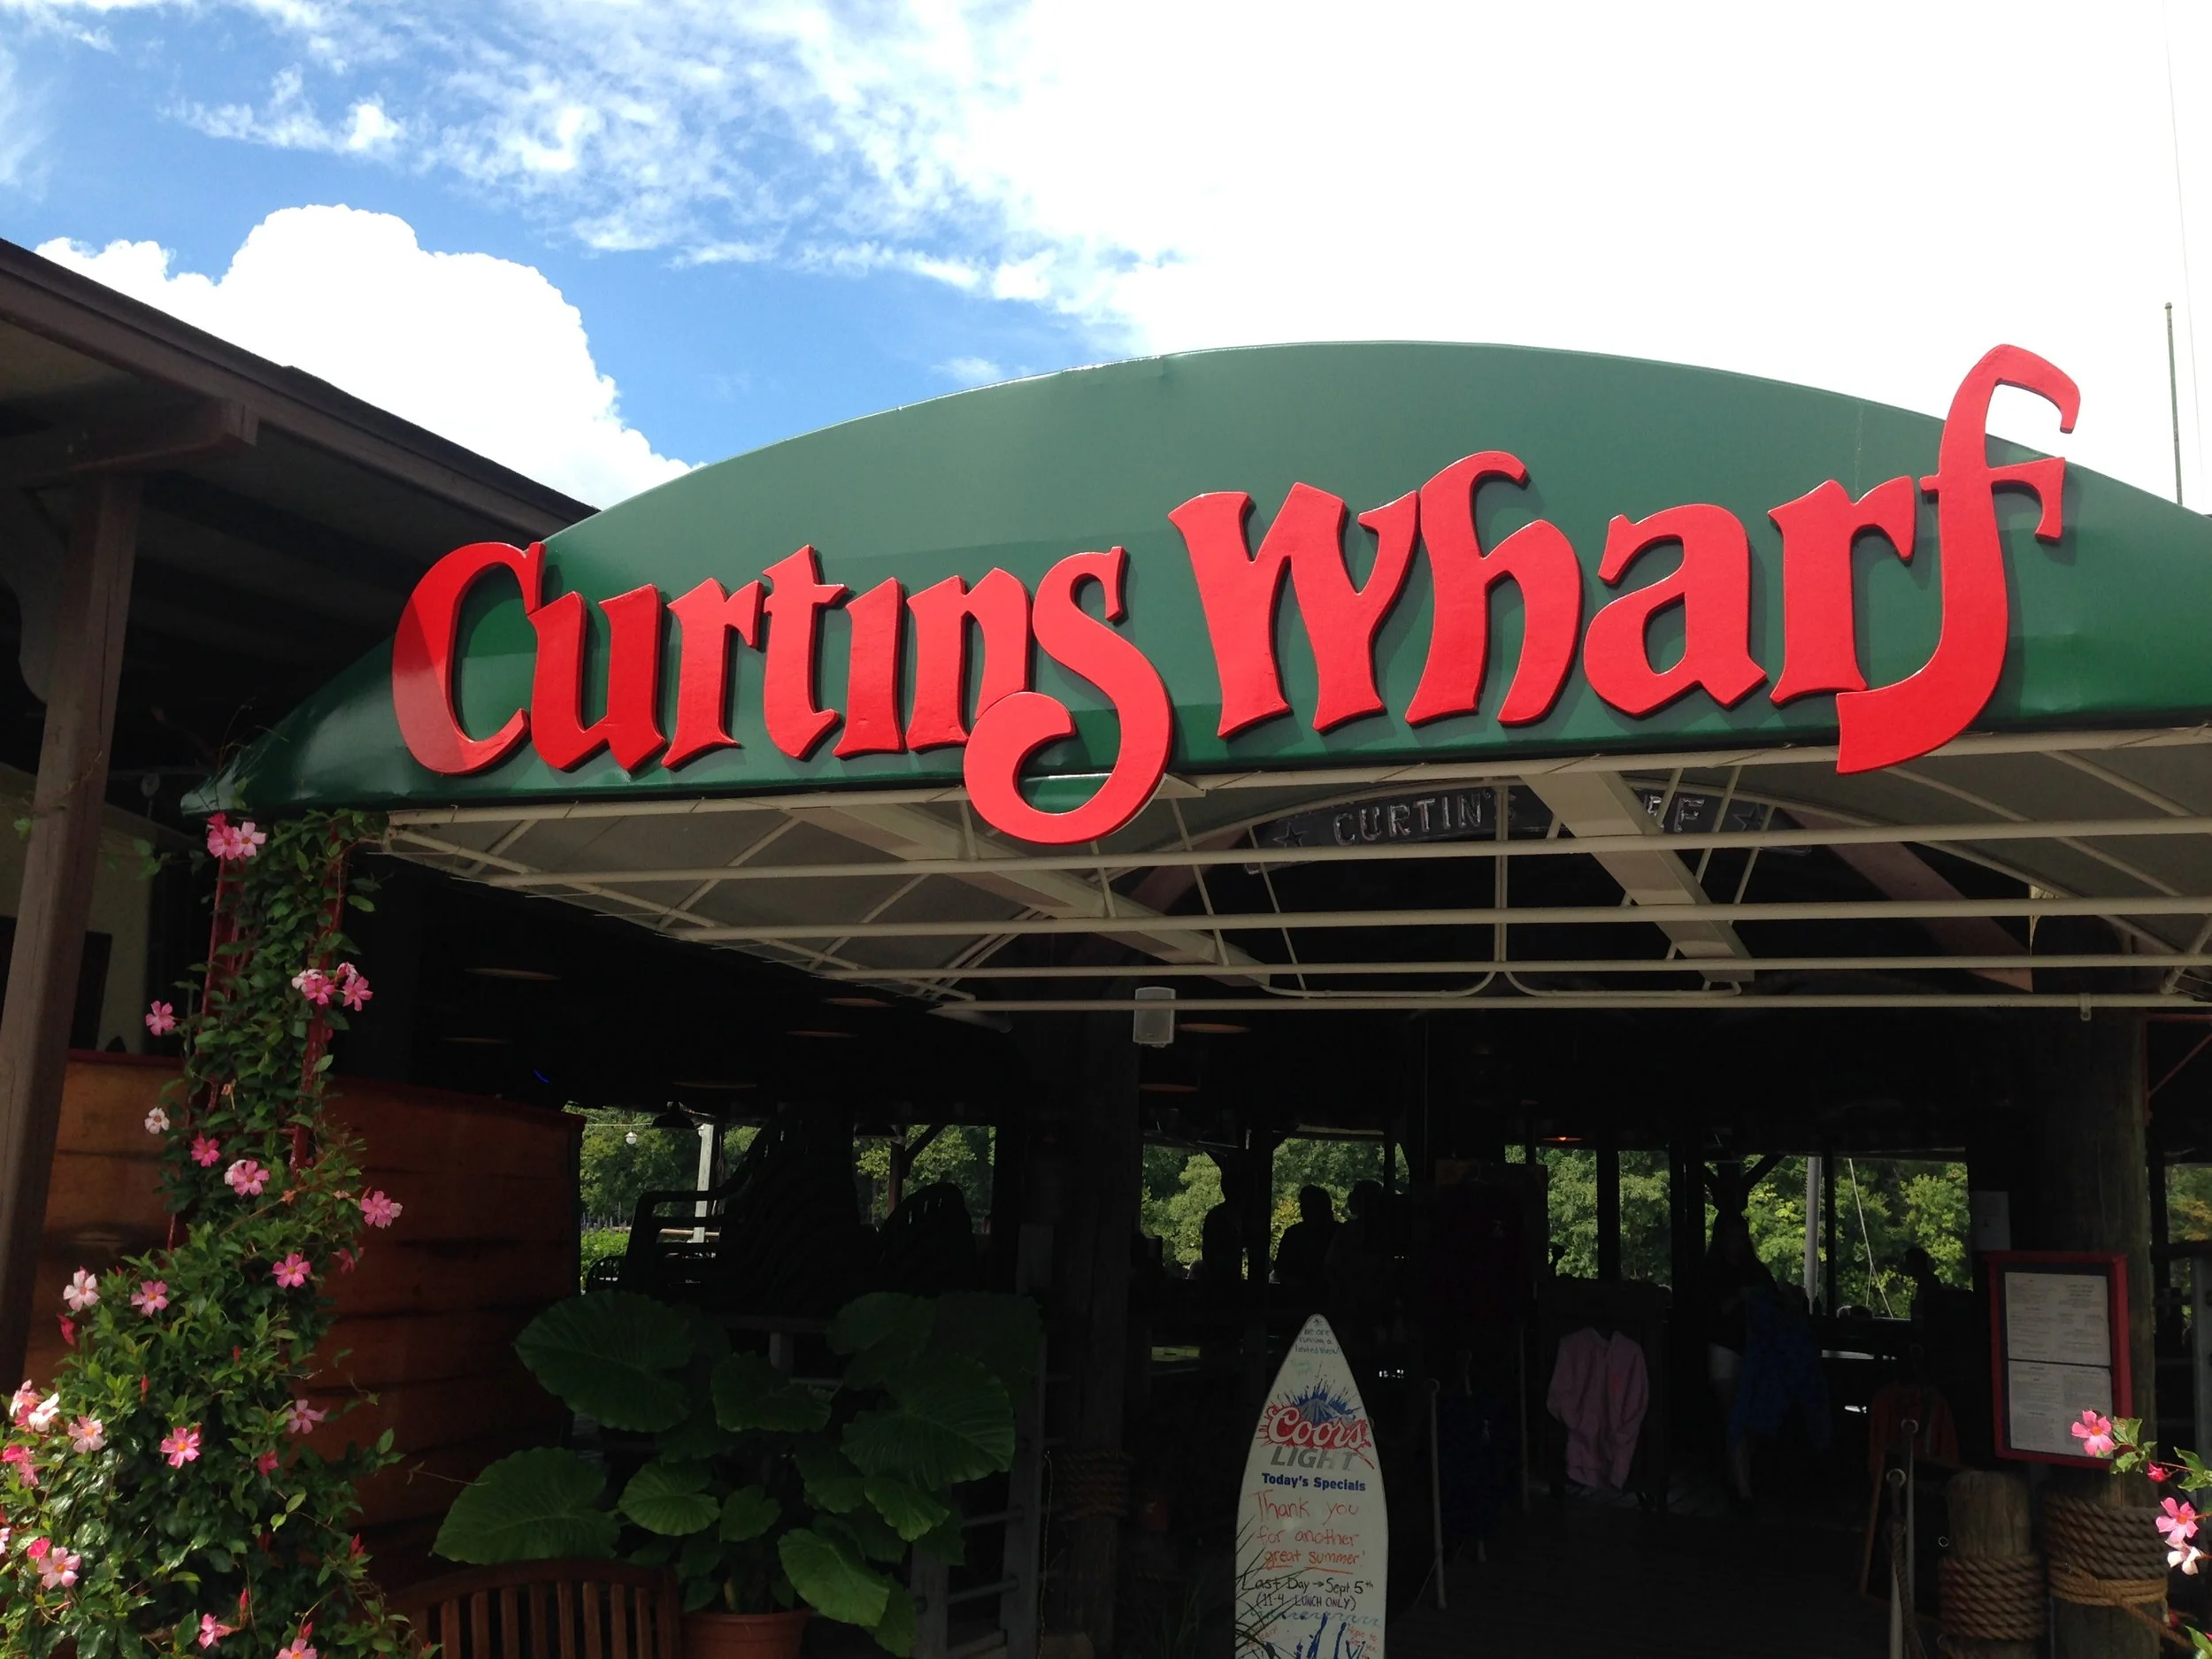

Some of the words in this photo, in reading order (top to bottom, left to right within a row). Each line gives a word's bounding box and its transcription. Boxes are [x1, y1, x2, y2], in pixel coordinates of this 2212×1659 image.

[1169, 343, 2081, 775] Wharf
[1267, 1406, 1364, 1448] Coors
[1271, 1446, 1359, 1471] LIGHT
[1262, 1472, 1309, 1488] Today's
[1313, 1477, 1366, 1491] Specials
[1250, 1489, 1310, 1522] Thank
[1322, 1502, 1359, 1526] you
[1256, 1525, 1286, 1546] for
[1294, 1529, 1359, 1547] another
[1263, 1549, 1302, 1570] great
[1286, 1577, 1310, 1594] Day
[1325, 1577, 1350, 1597] Sept
[1294, 1594, 1323, 1608] LUNCH
[1325, 1594, 1357, 1611] ONLY)
